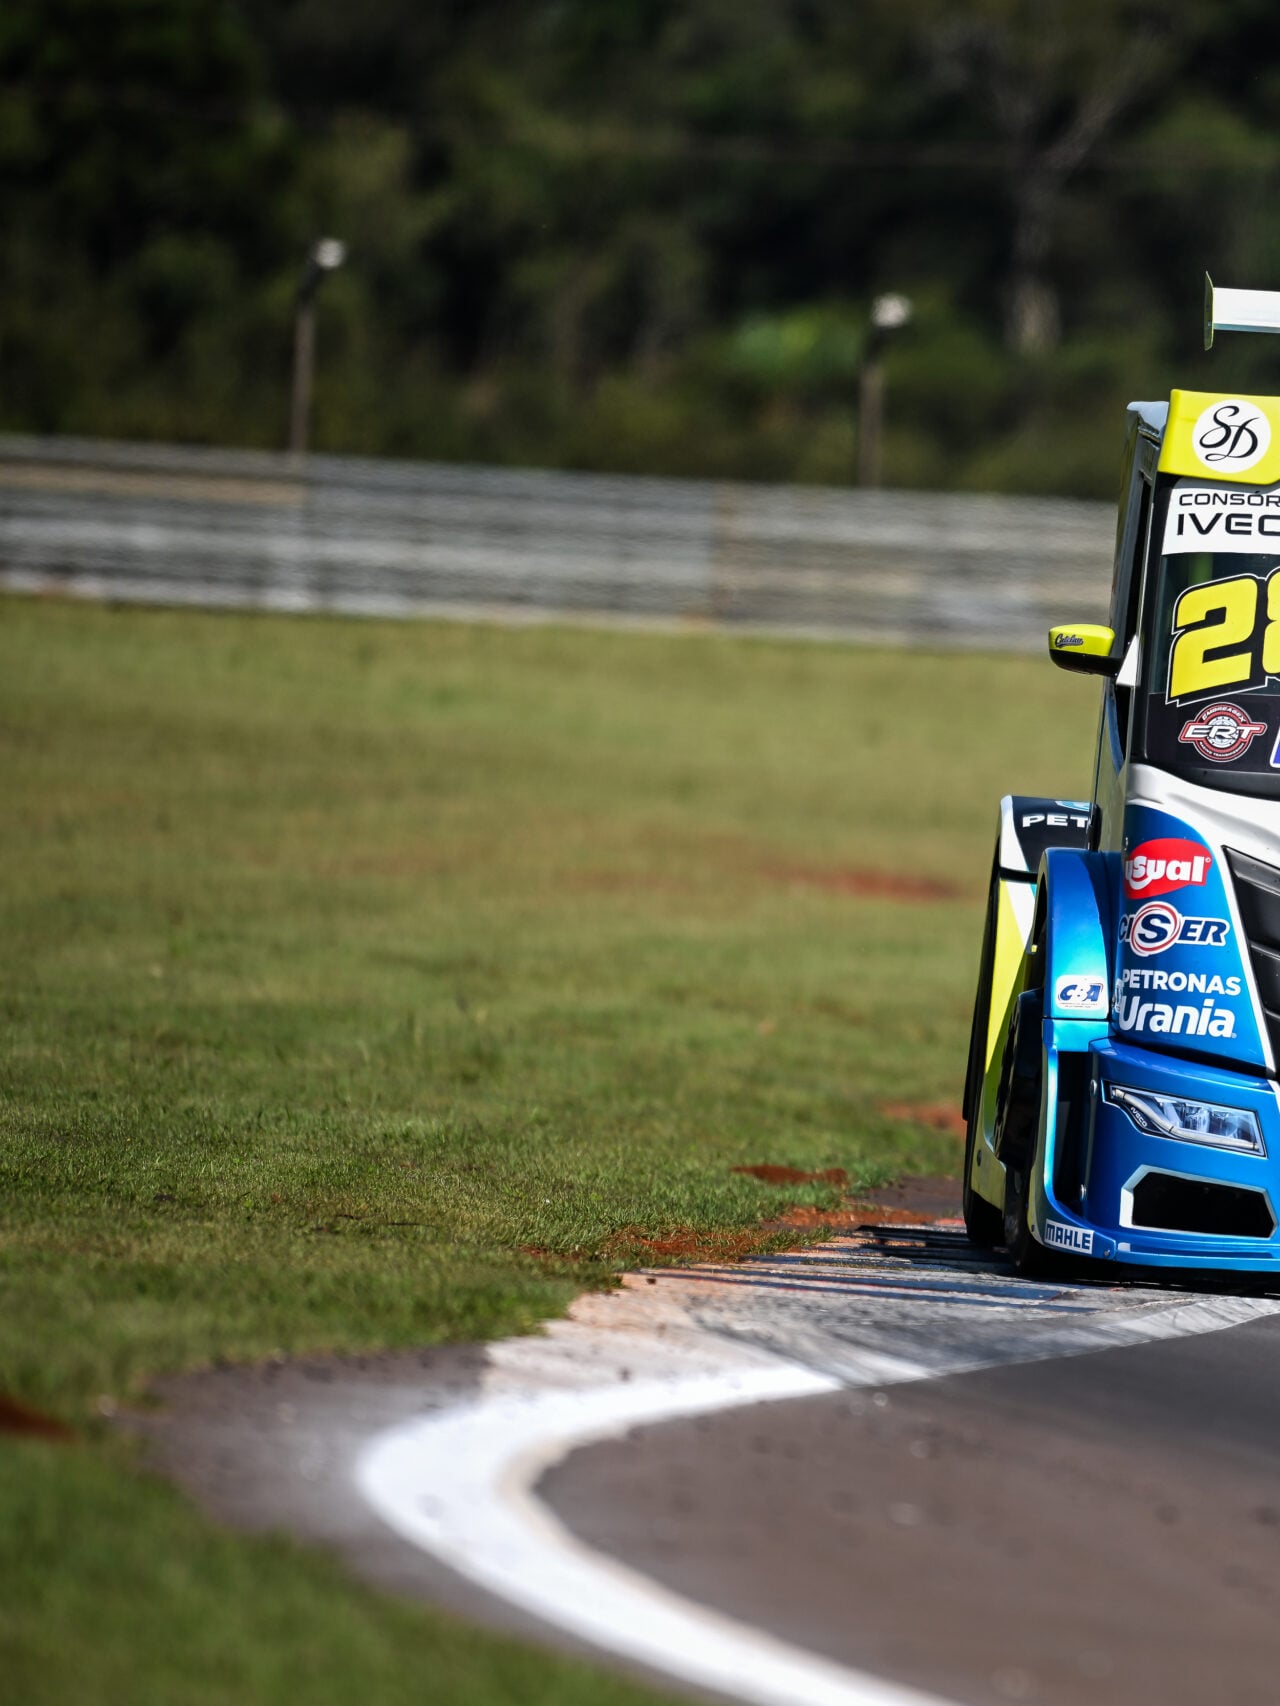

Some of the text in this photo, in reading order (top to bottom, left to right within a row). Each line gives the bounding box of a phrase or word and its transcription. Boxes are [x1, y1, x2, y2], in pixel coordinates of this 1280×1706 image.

[1184, 724, 1261, 740] ERT
[1124, 855, 1205, 891] usual
[1118, 911, 1228, 946] CISER
[1121, 968, 1242, 997] PETRONAS
[1118, 995, 1236, 1039] Urania
[1045, 1223, 1091, 1250] MAHLE
